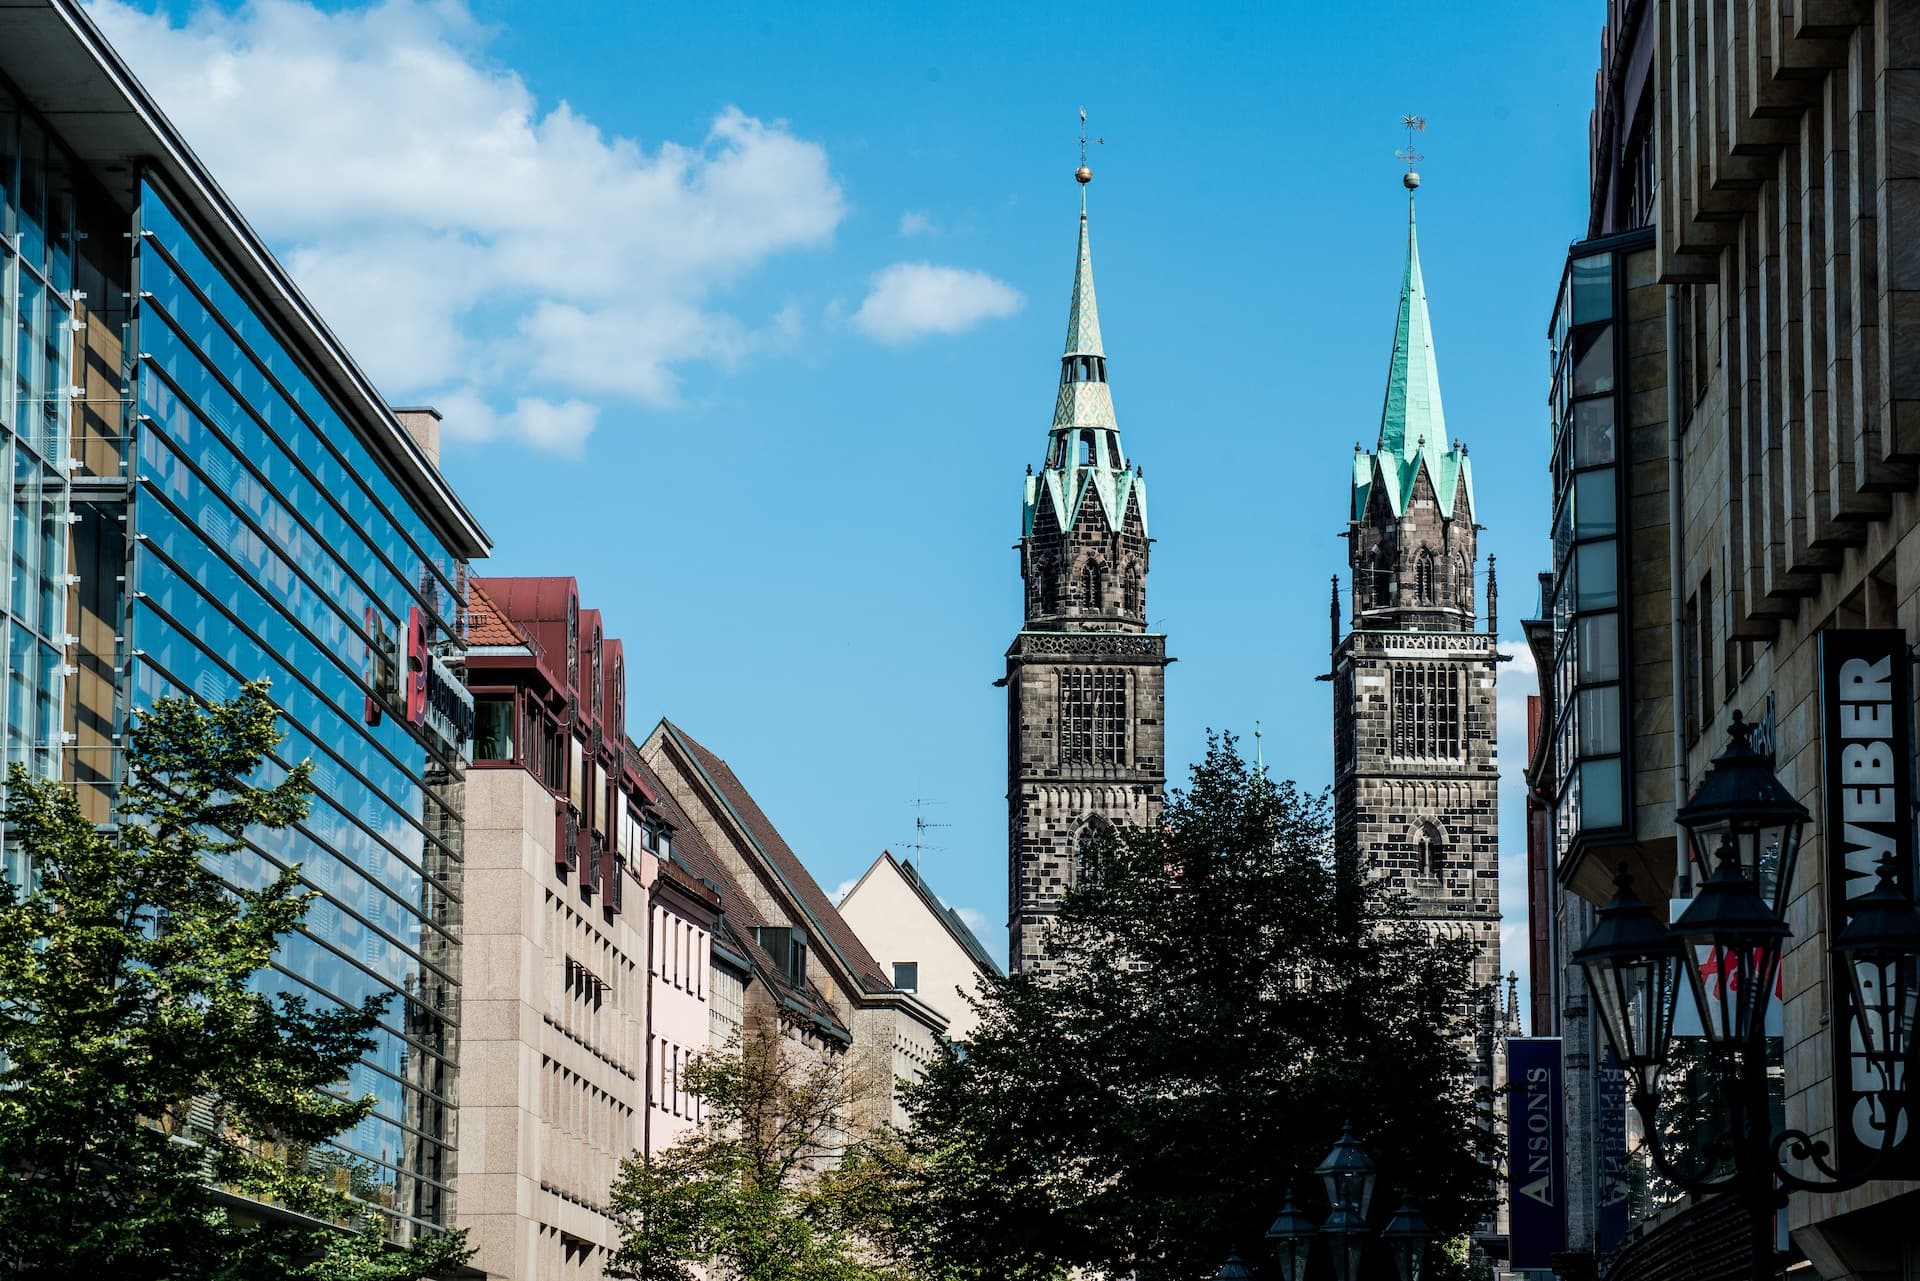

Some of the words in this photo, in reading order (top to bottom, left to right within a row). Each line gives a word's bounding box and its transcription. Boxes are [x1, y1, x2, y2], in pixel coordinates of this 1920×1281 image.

[1838, 654, 1895, 900] WEBER
[1518, 1067, 1552, 1208] ANSON'S
[1846, 914, 1908, 1149] GERR
